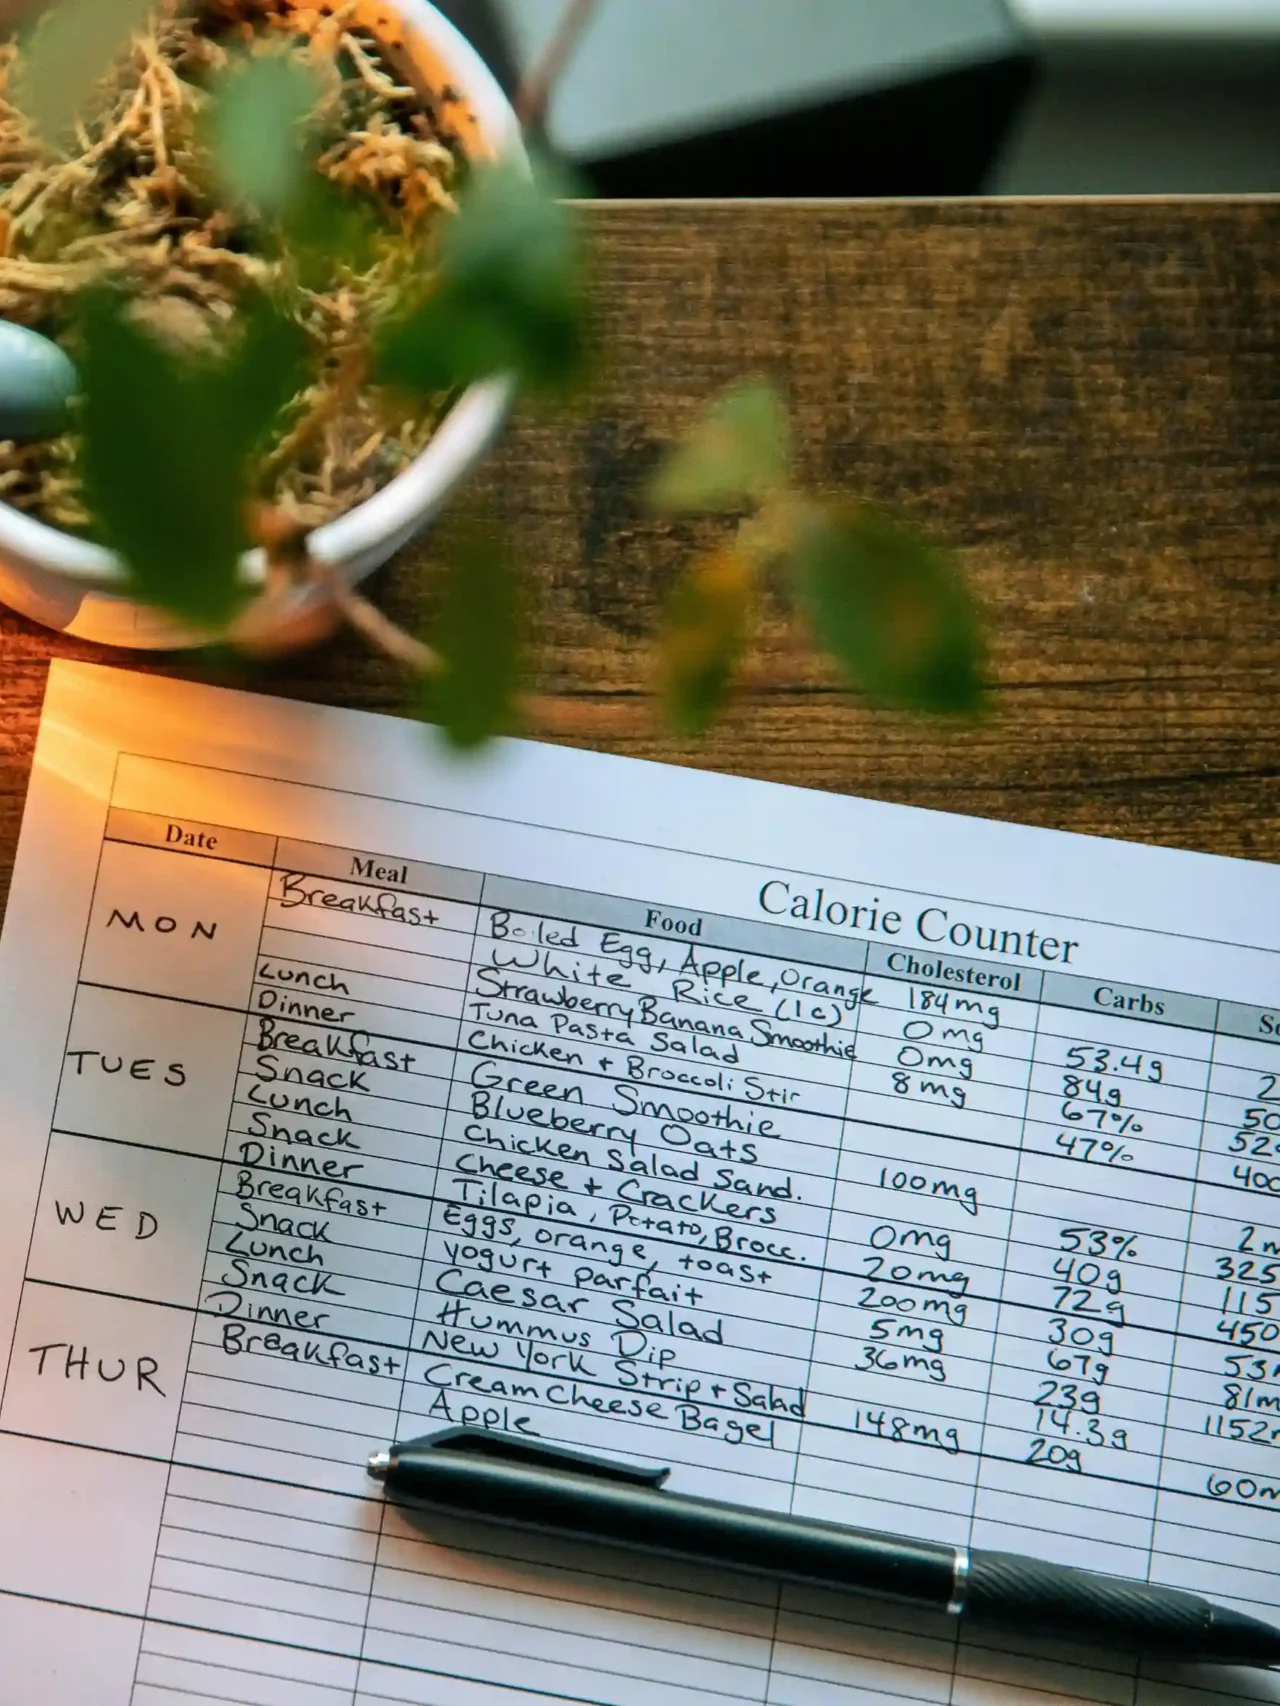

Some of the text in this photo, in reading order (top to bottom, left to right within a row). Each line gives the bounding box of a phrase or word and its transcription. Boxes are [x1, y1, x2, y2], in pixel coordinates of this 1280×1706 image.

[165, 824, 218, 850] Date
[349, 857, 409, 885] Meal
[280, 872, 439, 926] Breakfast
[106, 909, 218, 940] MON
[644, 908, 704, 936] Food
[758, 879, 1079, 965] Calorie Counter
[259, 963, 351, 995] Lunch
[491, 947, 632, 988] White
[672, 979, 764, 1013] Rice
[886, 952, 1021, 992] Cholesterol
[257, 989, 356, 1023] Dinner
[475, 966, 859, 1060] Strawberry Banana Smoothie
[1093, 986, 1166, 1016] Carbs
[256, 1016, 416, 1072] Breakfast
[469, 1003, 739, 1064] Tuna Pasta Salad
[67, 1050, 187, 1087] TUES
[255, 1055, 370, 1092] Snack
[468, 1029, 583, 1066] Chicken
[627, 1055, 733, 1092] Broccoli
[744, 1076, 801, 1104] Stir
[1065, 1046, 1163, 1084] 53.4g
[247, 1084, 353, 1122] Lunch
[470, 1060, 781, 1139] Green Smoothie
[1062, 1074, 1122, 1108] 84g
[247, 1112, 362, 1149] Snack
[471, 1091, 759, 1164] Blueberry Oats
[1061, 1100, 1144, 1134] 67%
[238, 1141, 364, 1178] Dinner
[464, 1125, 590, 1166] Chicken
[607, 1149, 699, 1182] Salad
[1056, 1132, 1135, 1163] 47%
[235, 1169, 387, 1216] Breakfast
[455, 1153, 569, 1189] Cheese
[617, 1178, 777, 1225] Crackers
[879, 1167, 978, 1216] 100mg
[54, 1200, 159, 1240] WED
[235, 1202, 334, 1243] Snack
[225, 1231, 324, 1266] Lunch
[1059, 1227, 1138, 1261] 53%
[221, 1258, 345, 1295] Snack
[678, 1254, 772, 1284] toast
[1053, 1257, 1122, 1296] 40g
[204, 1291, 330, 1329] Dinner
[436, 1268, 724, 1345] Caesar Salad
[222, 1323, 401, 1375] Breakfast
[436, 1299, 676, 1370] Hummus Dip
[1048, 1317, 1114, 1357] 30g
[28, 1343, 166, 1398] THUR
[422, 1330, 499, 1359] New
[517, 1340, 597, 1377] York
[614, 1358, 701, 1401] Strip
[733, 1381, 806, 1418] Salad
[1047, 1348, 1110, 1386] 67g
[424, 1363, 775, 1450] Cream Cheese Bagel
[428, 1388, 540, 1437] Apple
[1033, 1380, 1101, 1415] 23g
[854, 1410, 960, 1455] 148mg
[1025, 1438, 1083, 1474] 20g
